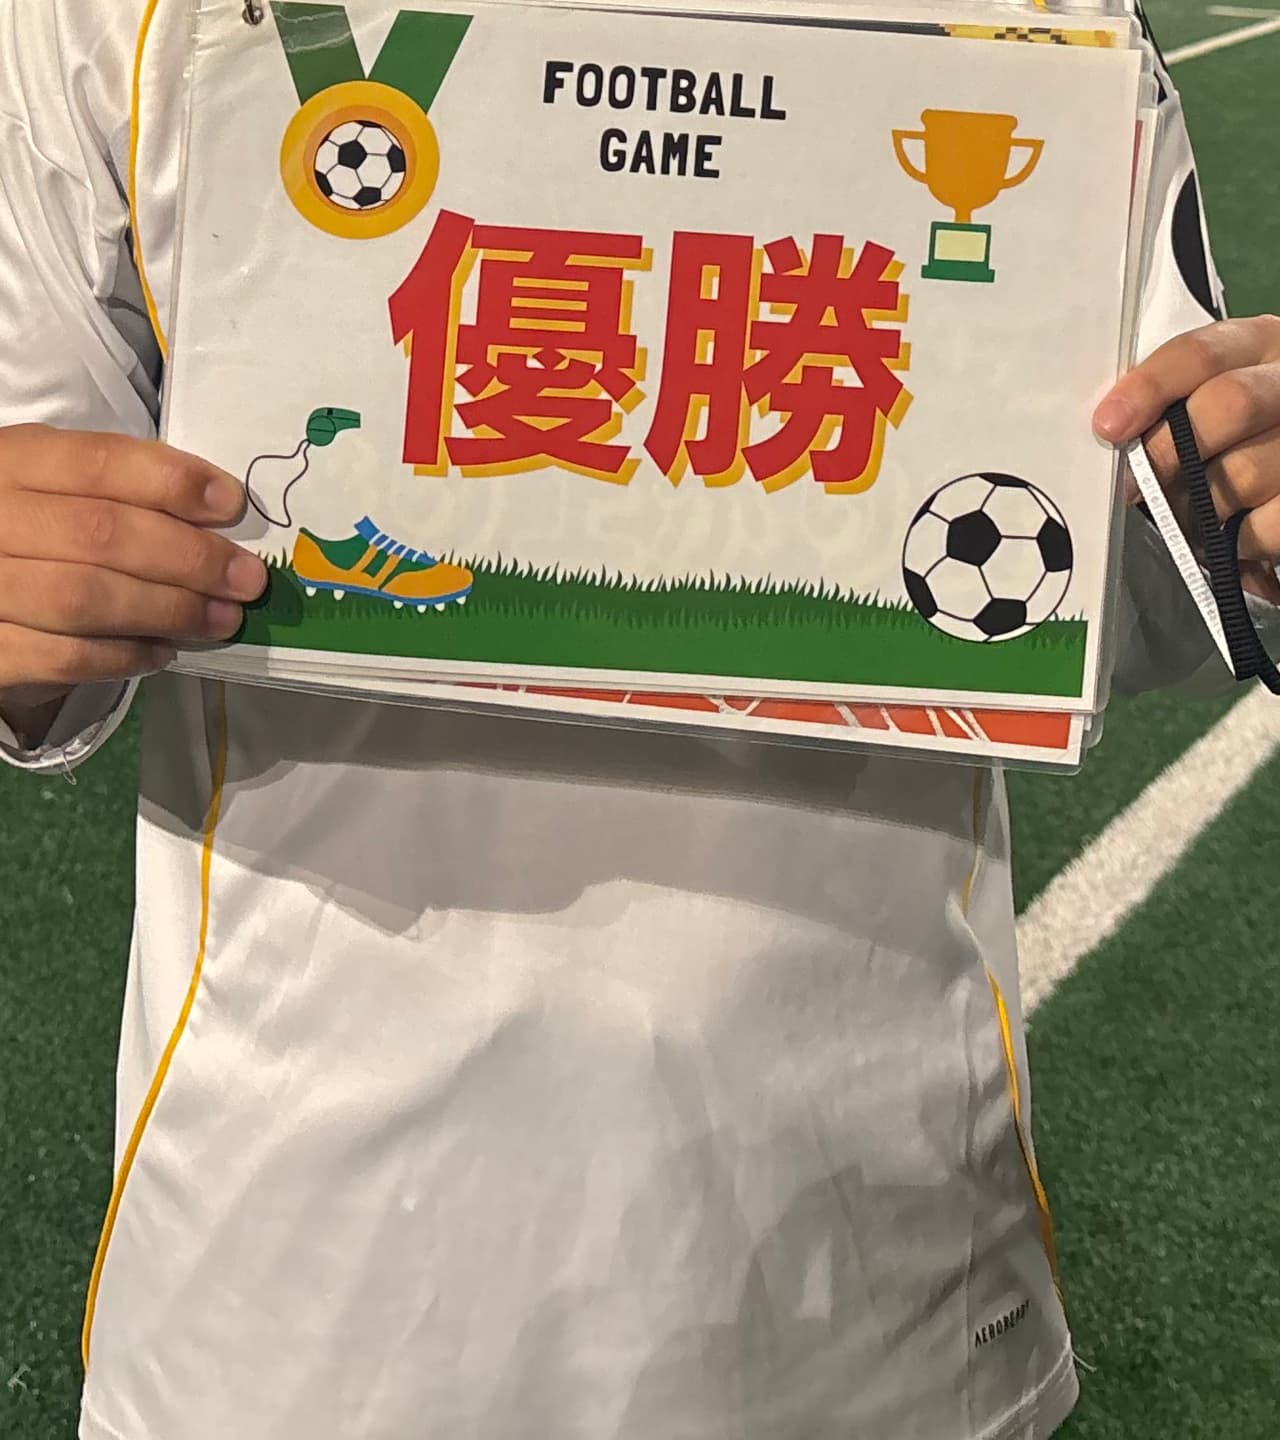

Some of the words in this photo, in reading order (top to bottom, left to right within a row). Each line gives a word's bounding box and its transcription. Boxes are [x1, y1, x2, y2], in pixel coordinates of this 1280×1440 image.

[541, 60, 787, 121] FOOTBALL
[599, 128, 722, 179] GAME
[387, 208, 910, 495] 優勝
